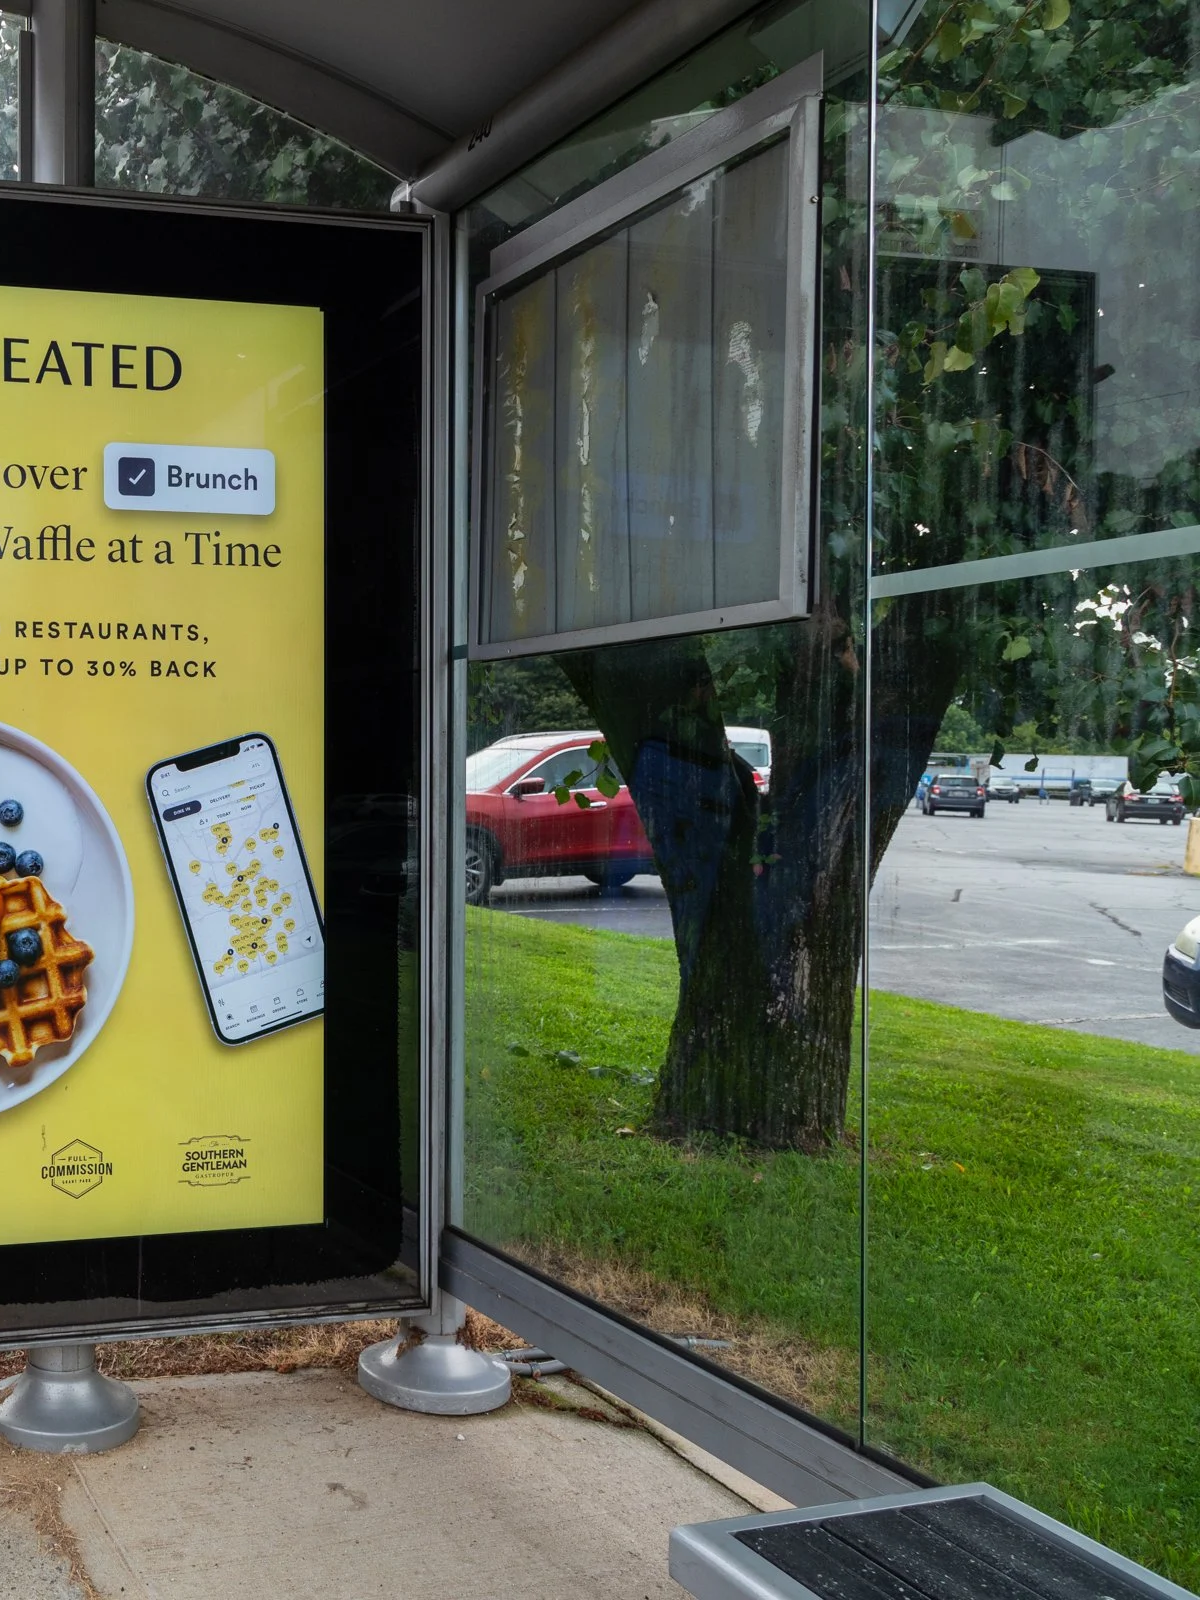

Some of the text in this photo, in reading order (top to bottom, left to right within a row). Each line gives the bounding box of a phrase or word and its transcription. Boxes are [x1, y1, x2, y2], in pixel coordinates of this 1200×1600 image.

[167, 465, 258, 490] Brunch
[107, 534, 143, 563] at
[154, 540, 174, 564] a
[185, 531, 282, 567] Time
[15, 620, 209, 644] RESTAURANTS,
[40, 659, 74, 676] TO
[86, 660, 137, 677] 30%
[151, 660, 216, 678] BACK
[210, 794, 231, 804] DELIVERY
[185, 1148, 244, 1161] SOUTHERN
[41, 1162, 113, 1180] COMMISSION
[182, 1159, 247, 1172] GENTLEMAN
